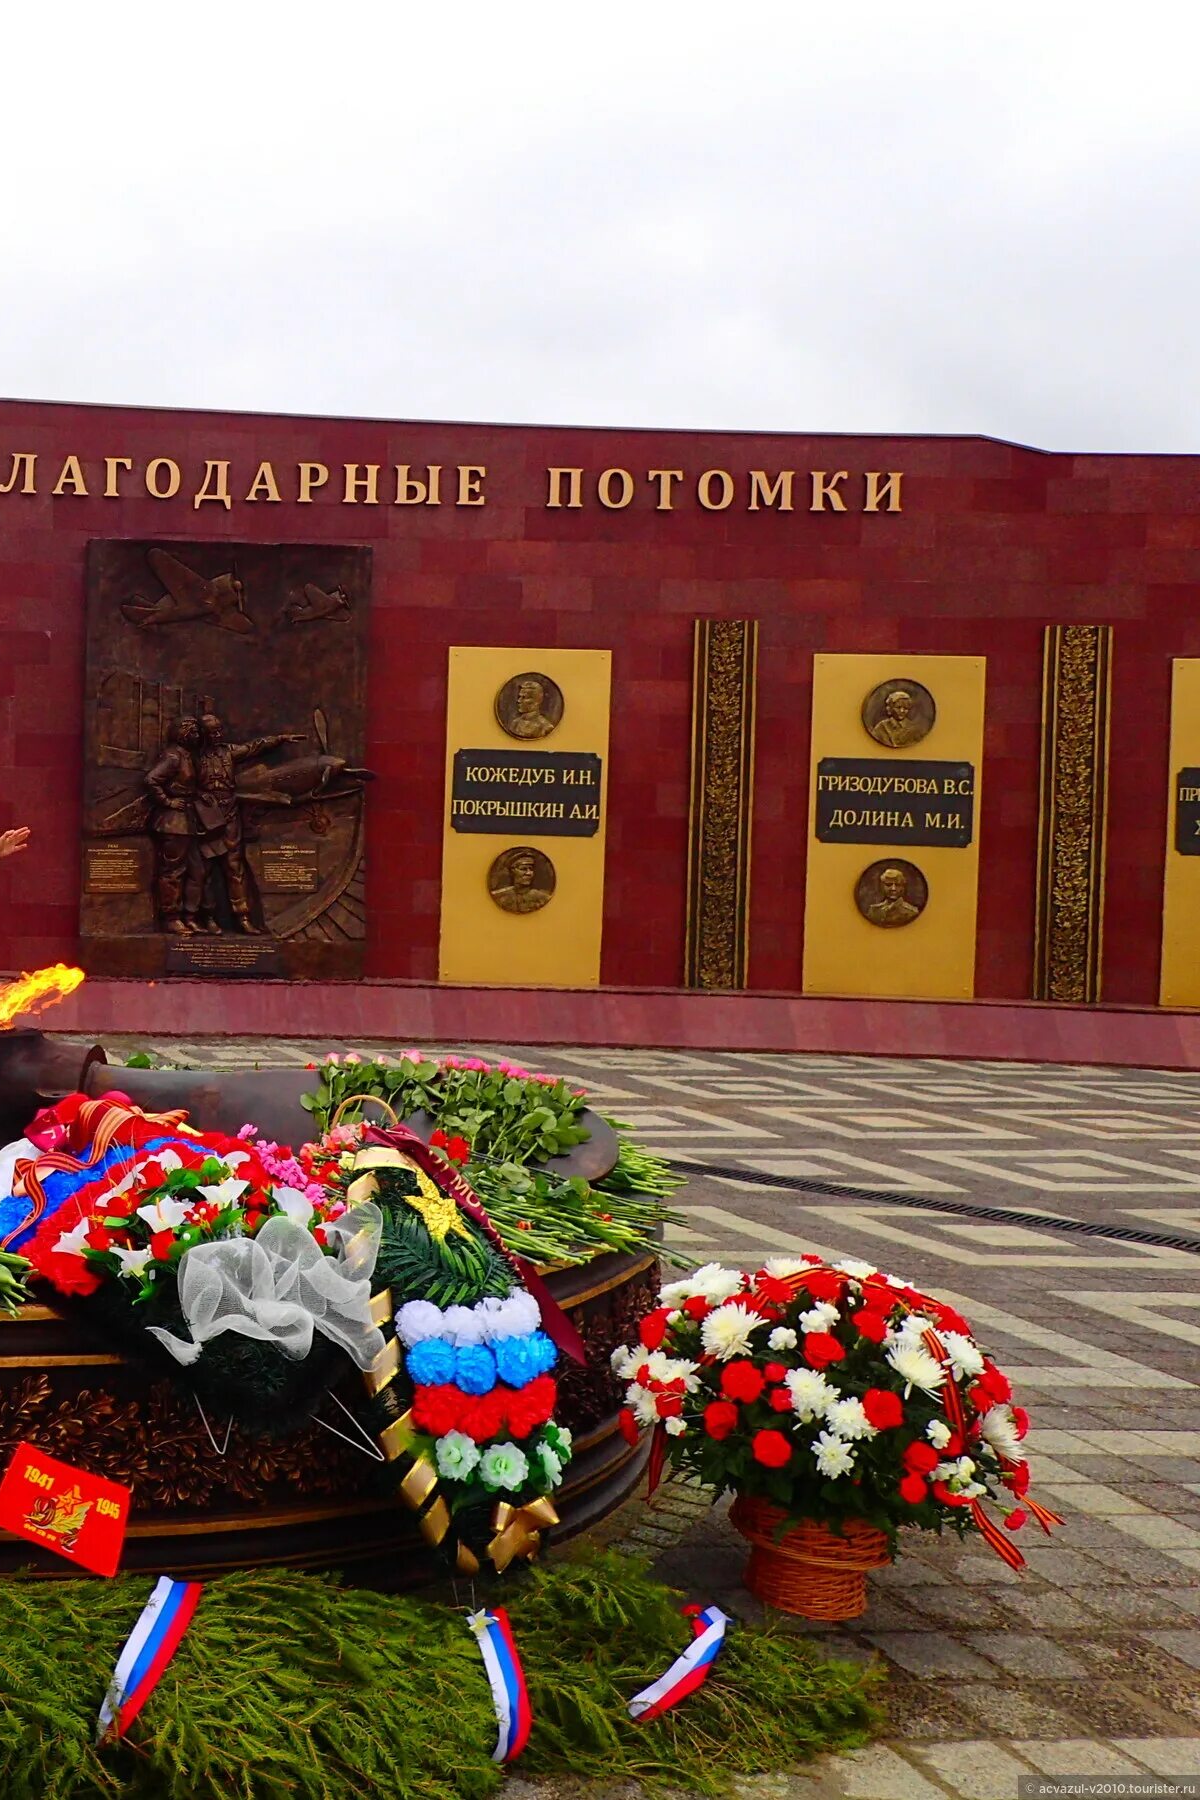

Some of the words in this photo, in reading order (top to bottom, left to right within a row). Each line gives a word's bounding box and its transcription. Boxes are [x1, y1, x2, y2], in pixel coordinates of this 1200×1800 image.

[546, 467, 904, 512] ПОТОМКИ
[465, 766, 556, 787] КОЖЕДУБ
[562, 769, 596, 786] И.Н.
[818, 775, 939, 795] ГРИЗОДУБОВА
[943, 779, 974, 796] В.С.
[1179, 787, 1200, 802] ПР
[452, 799, 564, 819] ПОКРЫШКИН
[569, 803, 599, 820] А.И.
[829, 809, 915, 828] ДОЛИНА
[924, 812, 965, 829] М.И.
[23, 1465, 55, 1491] 1941
[95, 1497, 121, 1520] 1945
